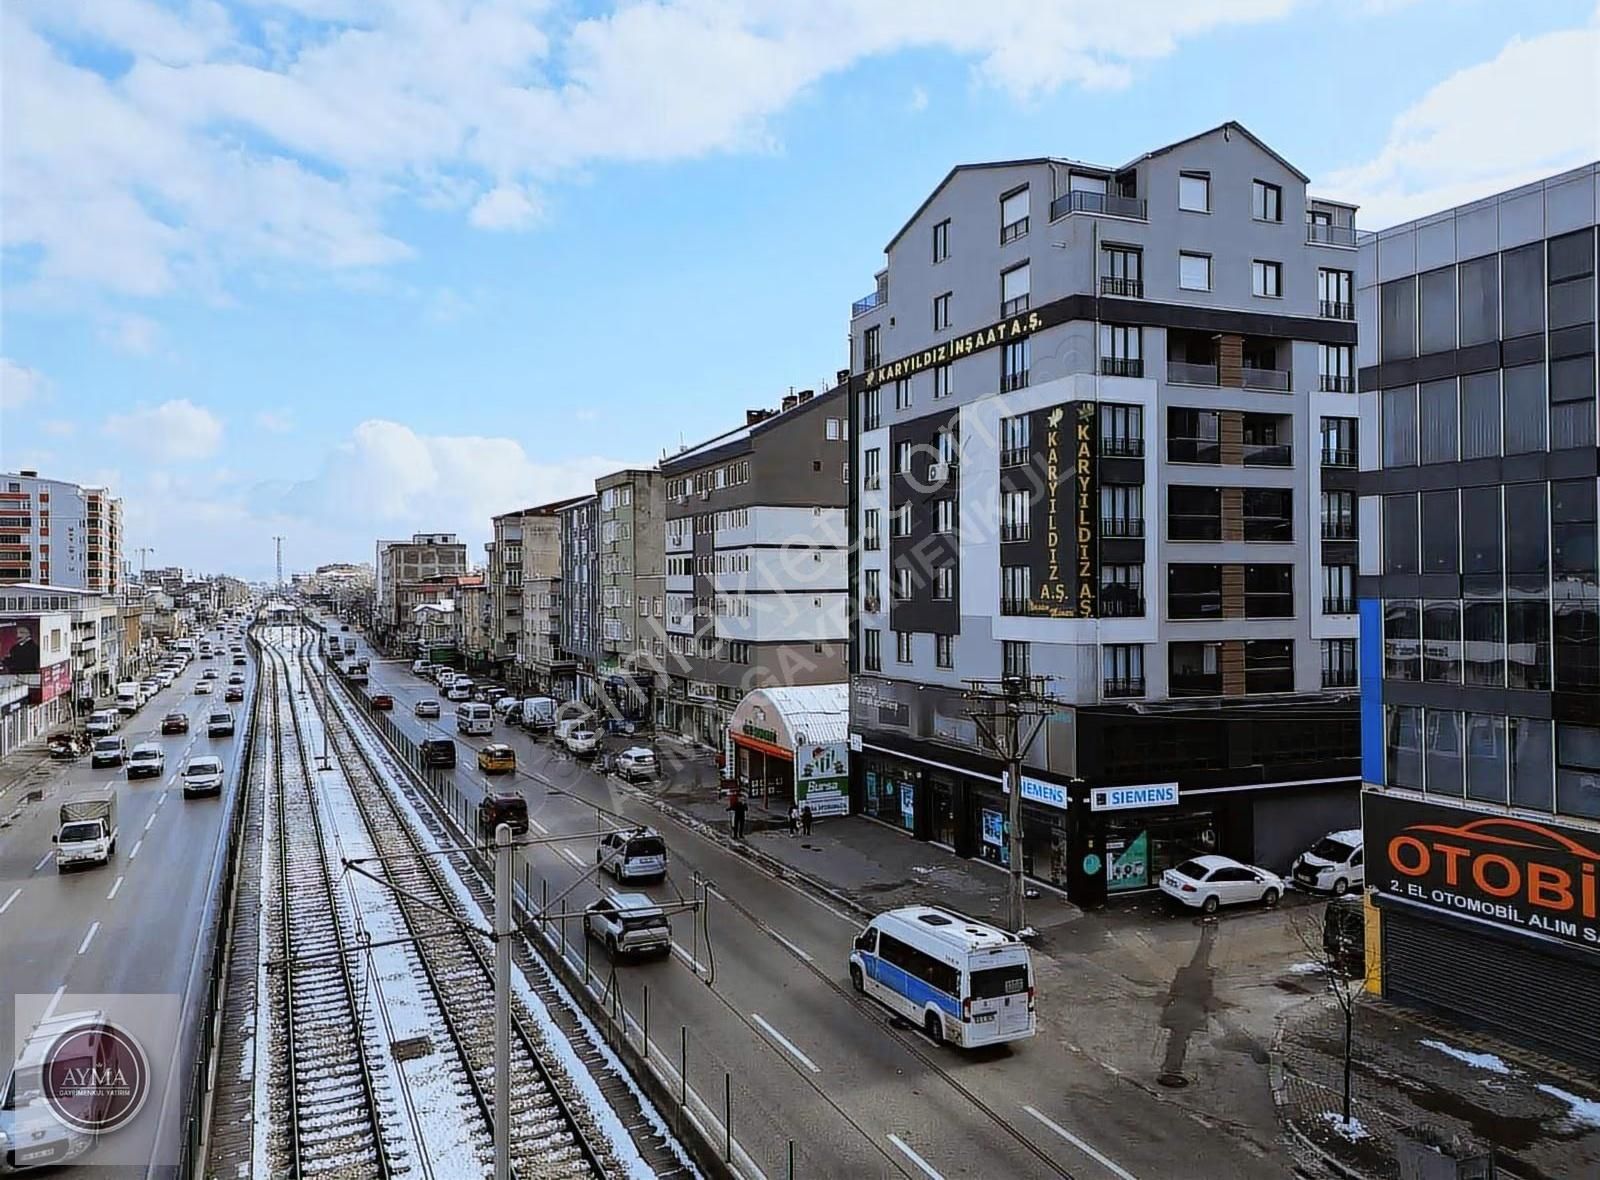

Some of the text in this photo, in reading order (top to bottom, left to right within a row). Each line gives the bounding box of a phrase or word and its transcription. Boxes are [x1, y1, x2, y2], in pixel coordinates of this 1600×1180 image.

[878, 312, 1043, 382] KARYILDIZ İNŞAAT A.Ş.
[1047, 431, 1058, 580] KARYILDIZ
[1077, 424, 1092, 577] KARYILDIZ
[1040, 584, 1068, 602] A.Ş.
[1022, 781, 1063, 802] IEMENS
[1111, 788, 1173, 804] SIEMENS
[1388, 836, 1595, 918] OTOBİ
[1390, 880, 1600, 943] 2. EL OTOMOBİL ALIM S
